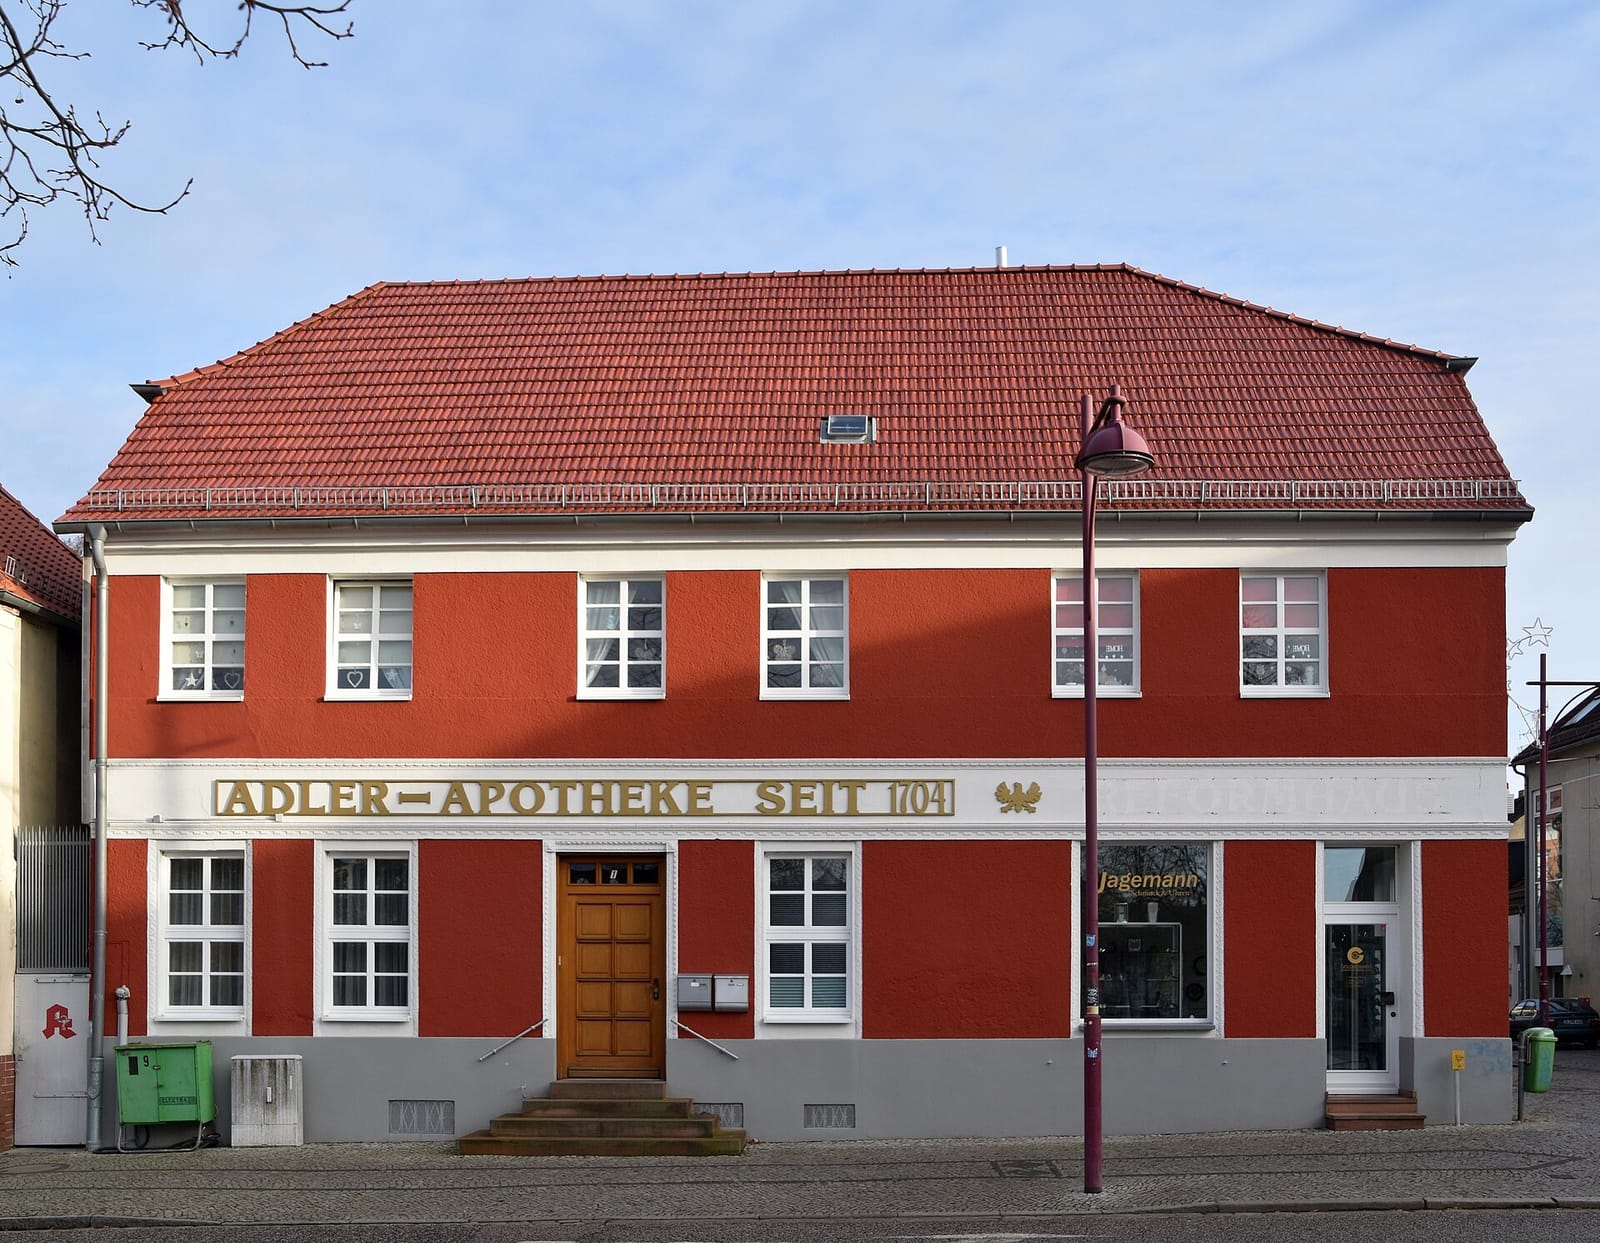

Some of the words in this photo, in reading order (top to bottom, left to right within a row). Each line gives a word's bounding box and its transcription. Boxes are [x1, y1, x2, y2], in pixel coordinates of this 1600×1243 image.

[755, 780, 867, 816] SEIT
[888, 781, 947, 815] 1704
[1097, 871, 1198, 894] Jagemann
[143, 1055, 150, 1067] 9
